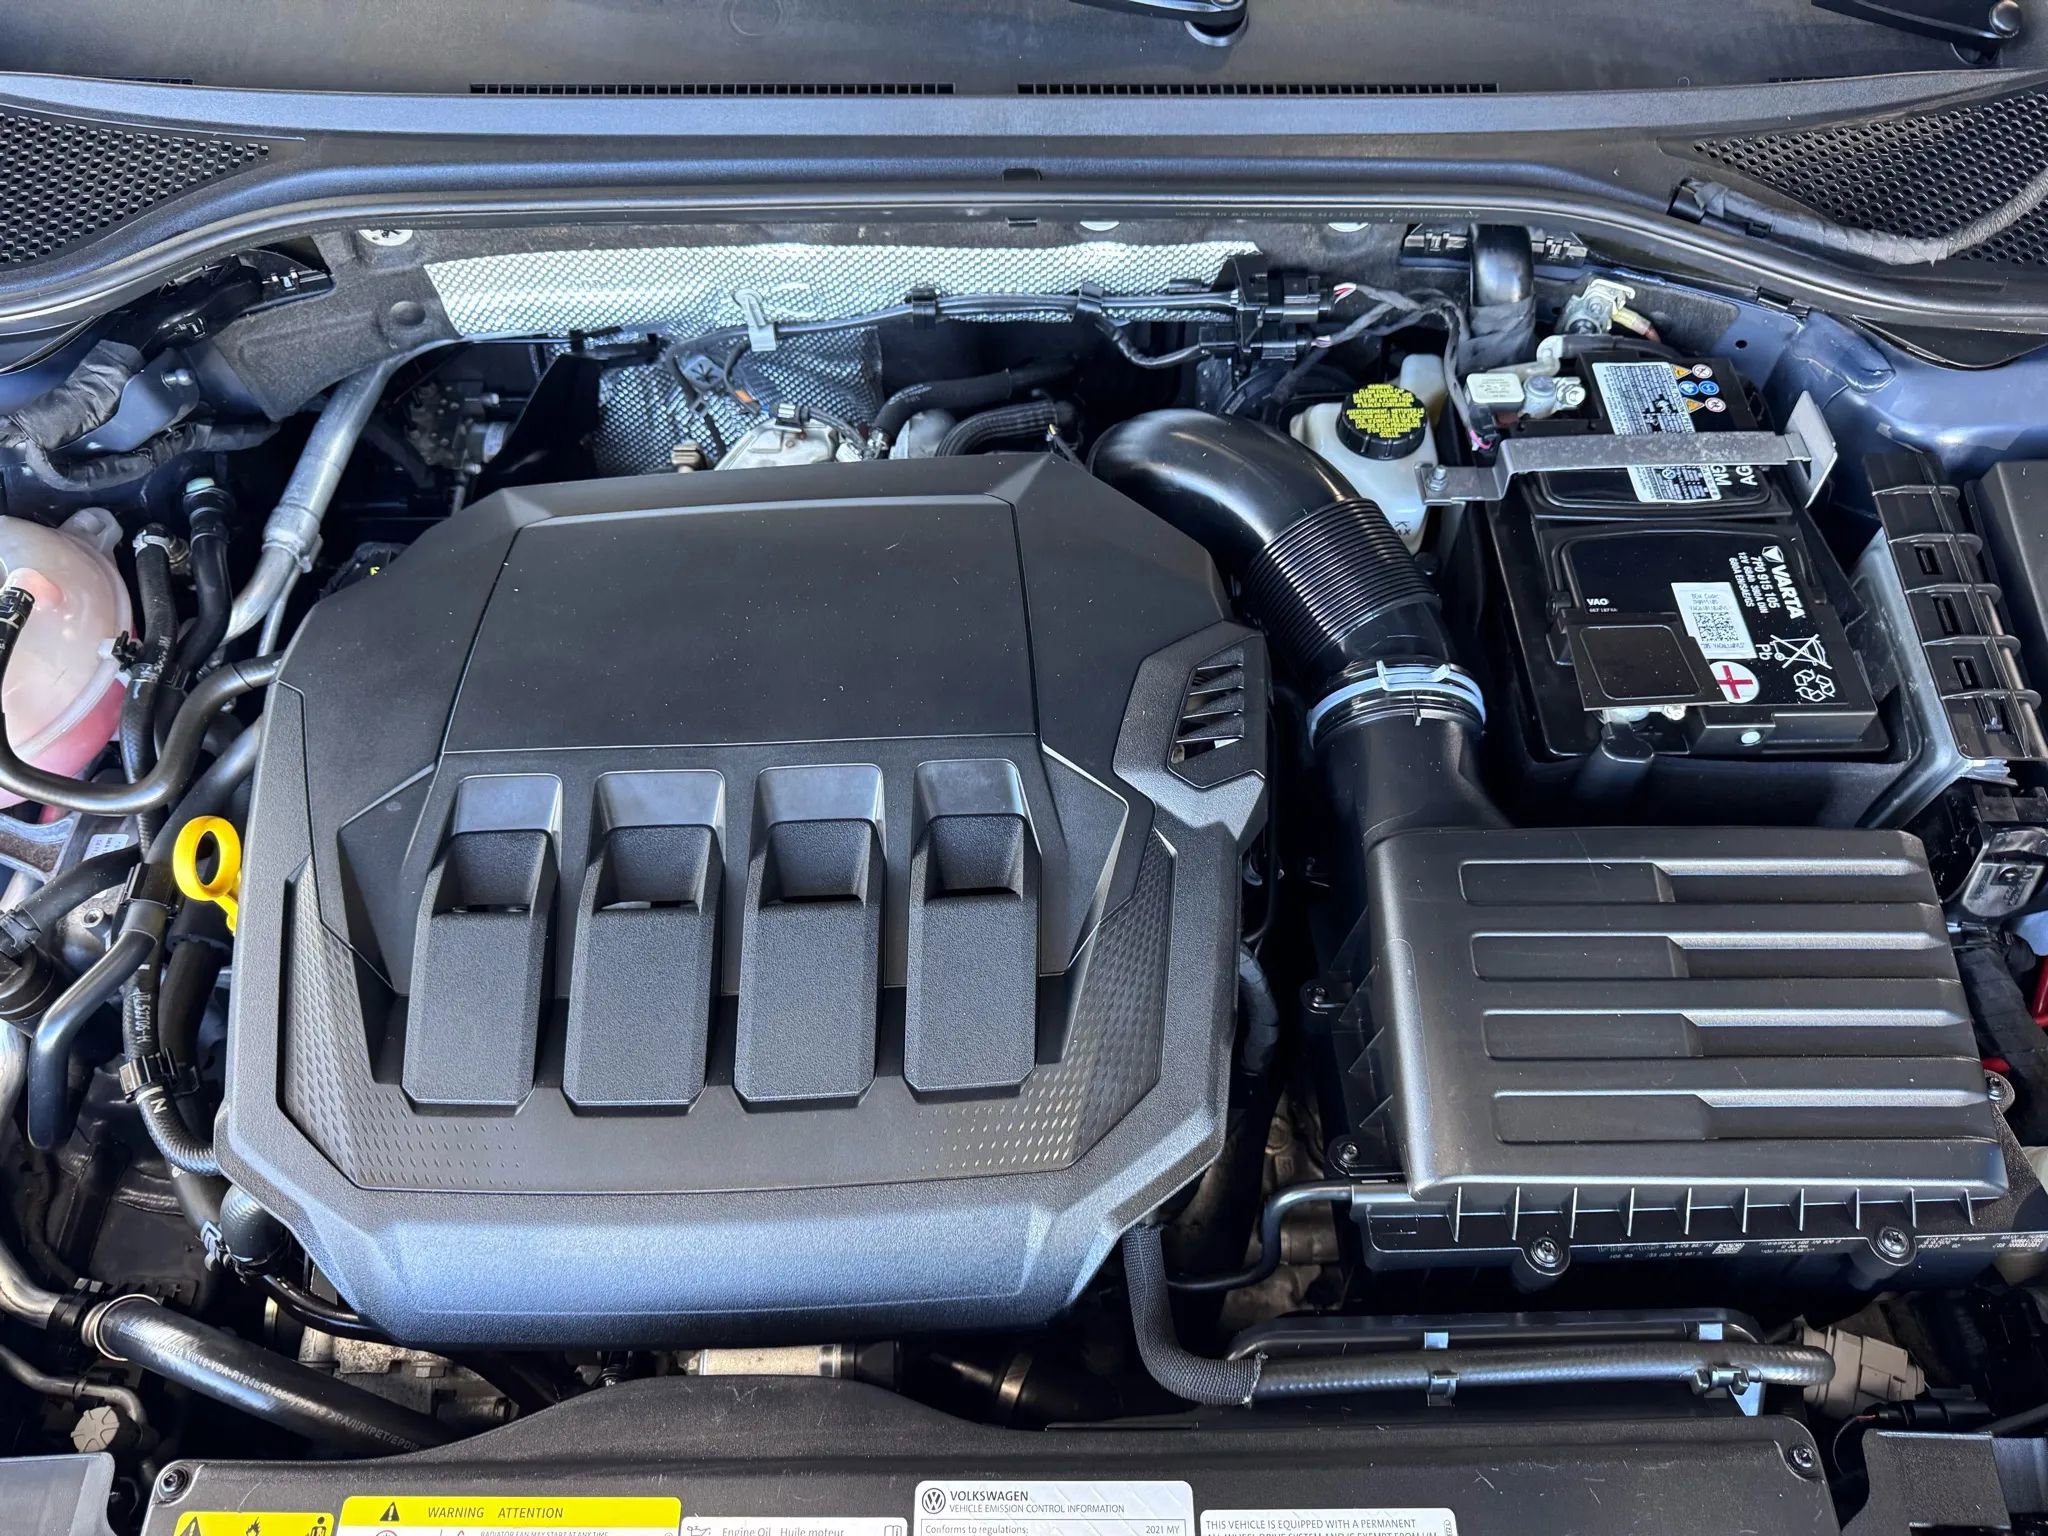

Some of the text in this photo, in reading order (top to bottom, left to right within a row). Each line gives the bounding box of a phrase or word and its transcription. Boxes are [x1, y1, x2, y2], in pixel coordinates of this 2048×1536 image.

[1736, 465, 1759, 486] AG
[1757, 574, 1773, 591] 915
[1765, 593, 1781, 609] 105
[1771, 564, 1805, 619] VARTA
[1756, 643, 1771, 660] Pb
[950, 1490, 1029, 1502] VOLKSWAGEN
[427, 1507, 564, 1519] WARNING ATTENTION
[949, 1503, 1125, 1513] VEHICLE EMISSION CONTROL INFORMATION
[925, 1525, 1180, 1536] Conforms to regulations: 2021 MY
[1206, 1519, 1416, 1531] THIS VEHICLE IS EQUIPPED WITH A PERMANENT
[722, 1527, 754, 1536] Engine
[757, 1527, 771, 1536] Oil
[780, 1527, 806, 1536] Huile
